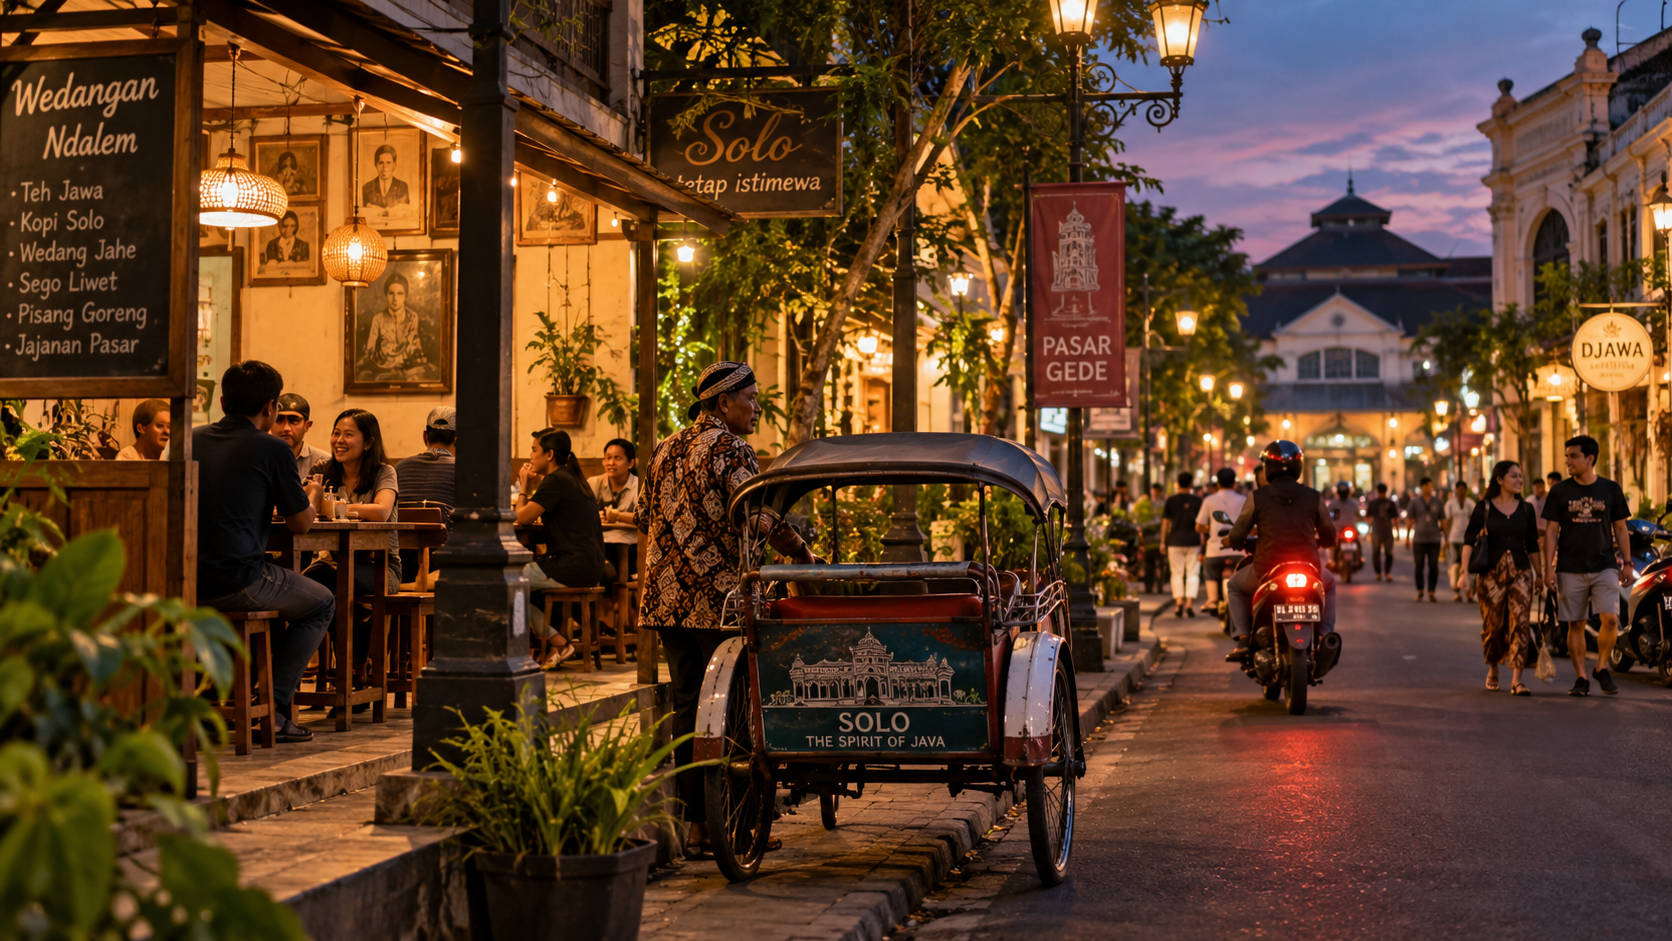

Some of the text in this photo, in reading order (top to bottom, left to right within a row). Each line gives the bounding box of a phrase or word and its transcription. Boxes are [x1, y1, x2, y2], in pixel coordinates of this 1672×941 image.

[11, 72, 159, 118] Wedangan
[43, 123, 138, 160] Ndalem
[684, 110, 803, 166] Solo
[20, 181, 104, 203] Teh Jawa
[735, 172, 821, 193] istimewa
[20, 209, 105, 237] Kopi Solo
[19, 239, 137, 268] Wedang Jahe
[19, 270, 118, 299] Sego Liwet
[18, 303, 148, 331] Pisang Goreng
[15, 333, 140, 362] Jajanan Pasar
[1043, 336, 1112, 356] PASAR
[1582, 342, 1644, 359] DJAWA
[1046, 361, 1108, 382] GEDE
[838, 711, 911, 733] SOLO
[805, 735, 946, 748] THE SPIRIT OF JAVA
